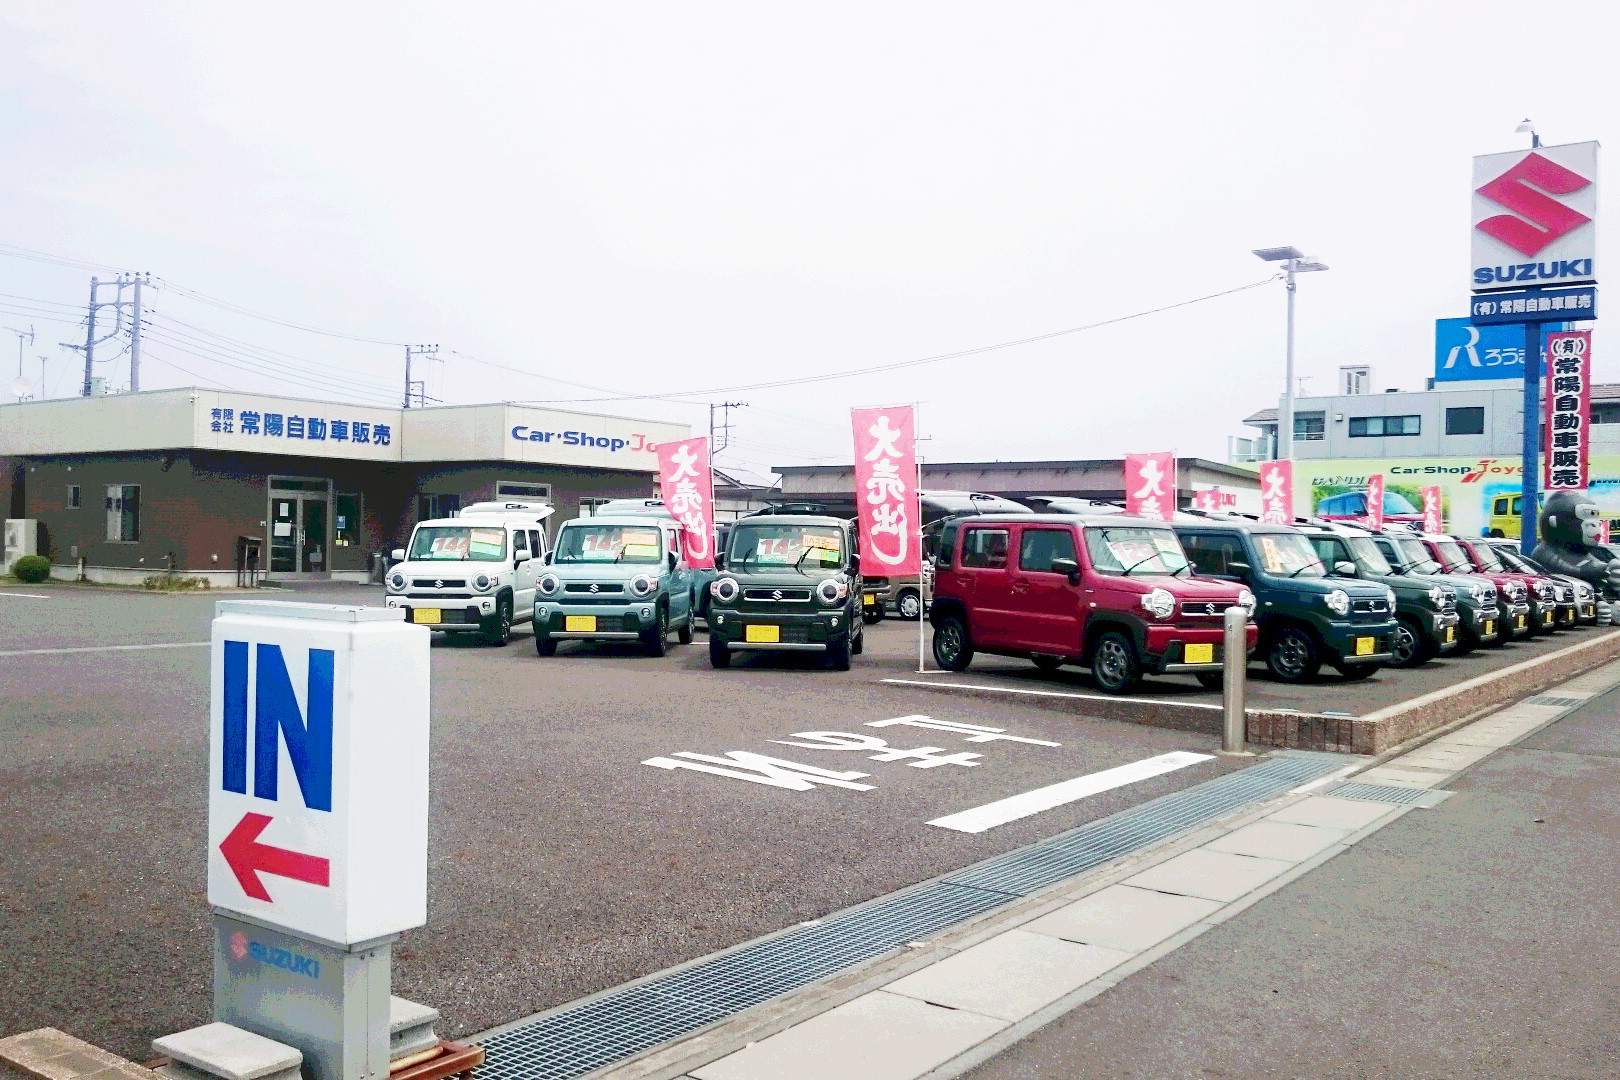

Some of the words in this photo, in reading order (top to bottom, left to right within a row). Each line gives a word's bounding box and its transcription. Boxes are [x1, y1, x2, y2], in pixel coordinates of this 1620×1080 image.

[1473, 258, 1592, 284] SUZUKI
[211, 407, 234, 421] 有限
[240, 410, 391, 446] 常陽自動車販売
[211, 420, 234, 433] 会社
[668, 444, 708, 560] 大売出し
[864, 415, 908, 565] 大売出し
[222, 639, 335, 812] IN
[640, 714, 1062, 791] 止まれ
[249, 941, 320, 979] SUZUKI
